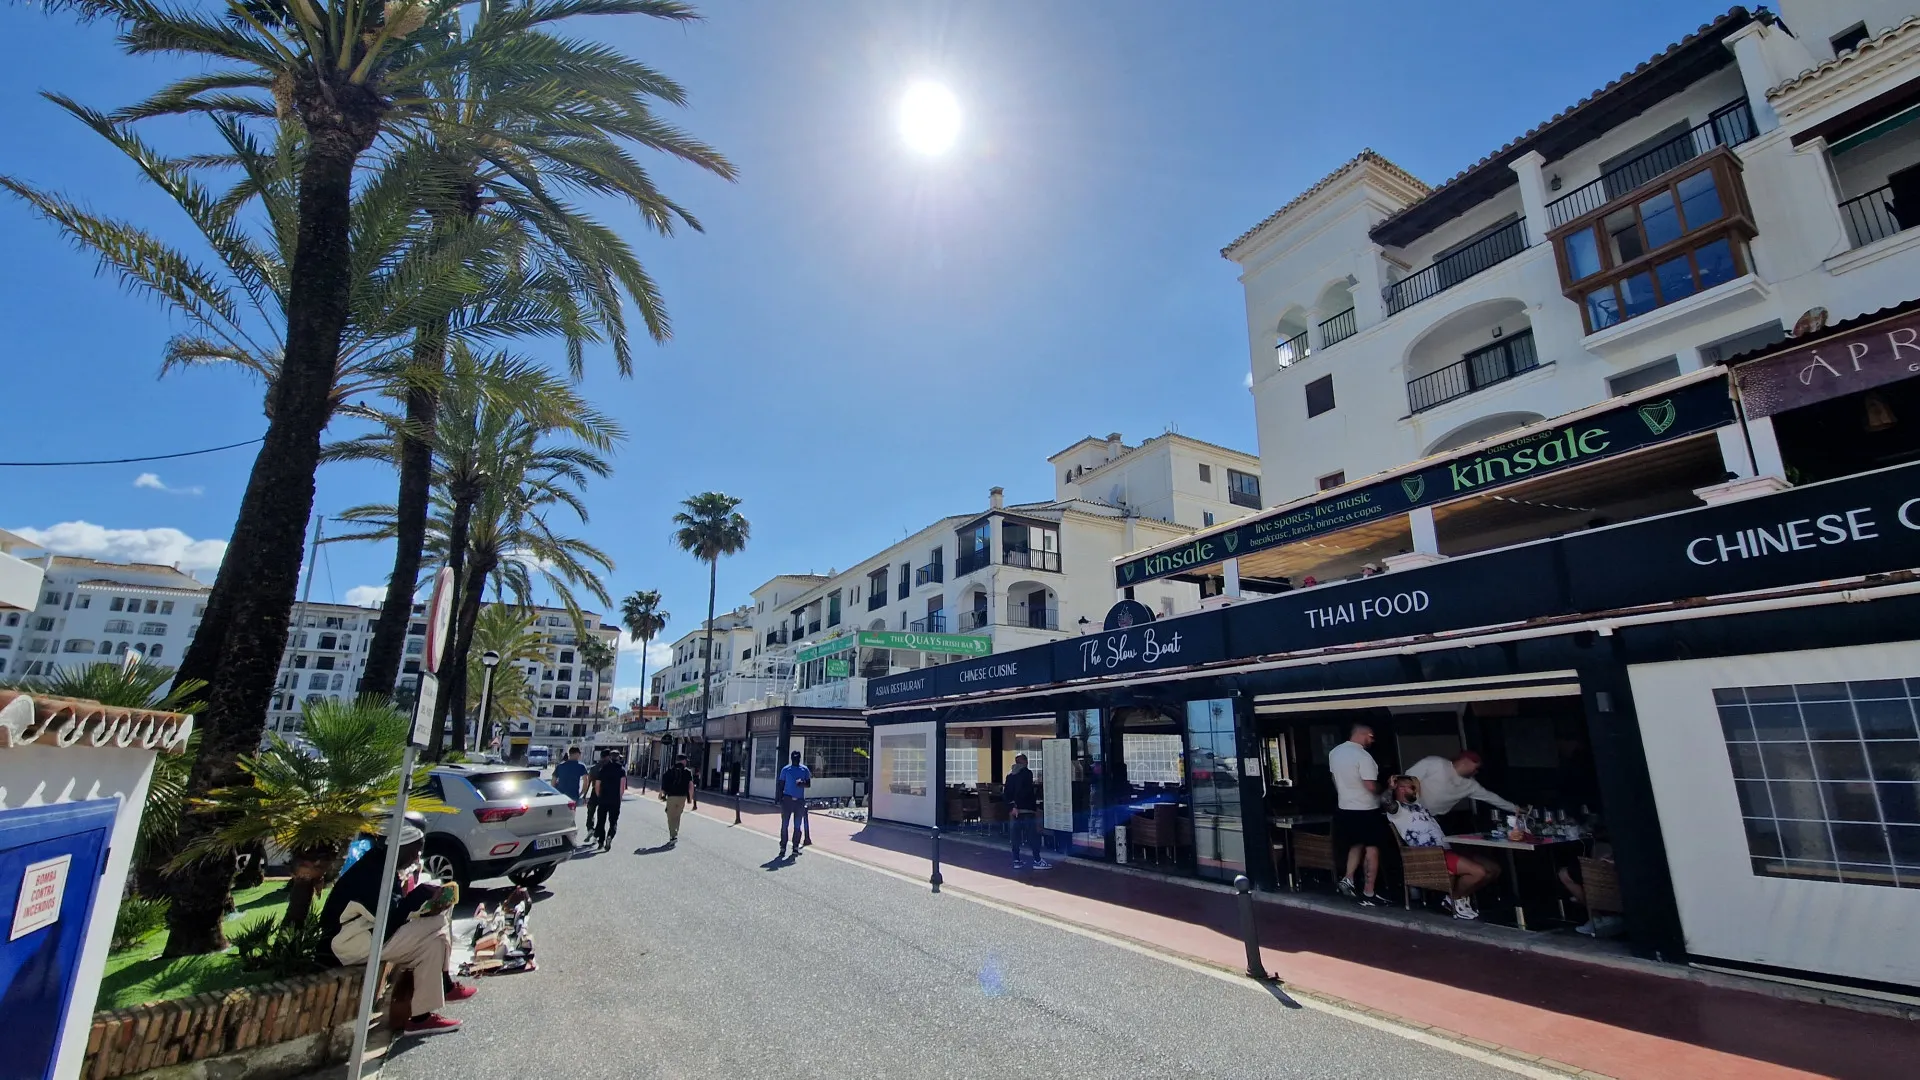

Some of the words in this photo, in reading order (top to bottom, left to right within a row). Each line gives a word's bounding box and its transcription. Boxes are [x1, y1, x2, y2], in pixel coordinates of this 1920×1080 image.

[1448, 426, 1611, 491] kinsale
[1255, 522, 1273, 534] live
[1315, 504, 1335, 517] live
[1337, 493, 1372, 510] music
[1687, 507, 1879, 566] CHINESE
[1143, 542, 1215, 576] kinsale
[1304, 602, 1355, 629] THAI
[1361, 590, 1429, 620] FOOD
[904, 633, 941, 648] QUAYS
[1079, 639, 1101, 672] The
[1105, 633, 1138, 668] Slow
[1142, 628, 1183, 663] Boat
[959, 668, 987, 683] CHINESE
[988, 662, 1018, 678] CUISINE
[875, 686, 890, 697] ASIAN
[890, 678, 925, 693] RESTAURANT
[35, 870, 57, 886] BOMBA
[31, 885, 55, 902] CONTRA
[23, 897, 56, 918] INCENDIOS
